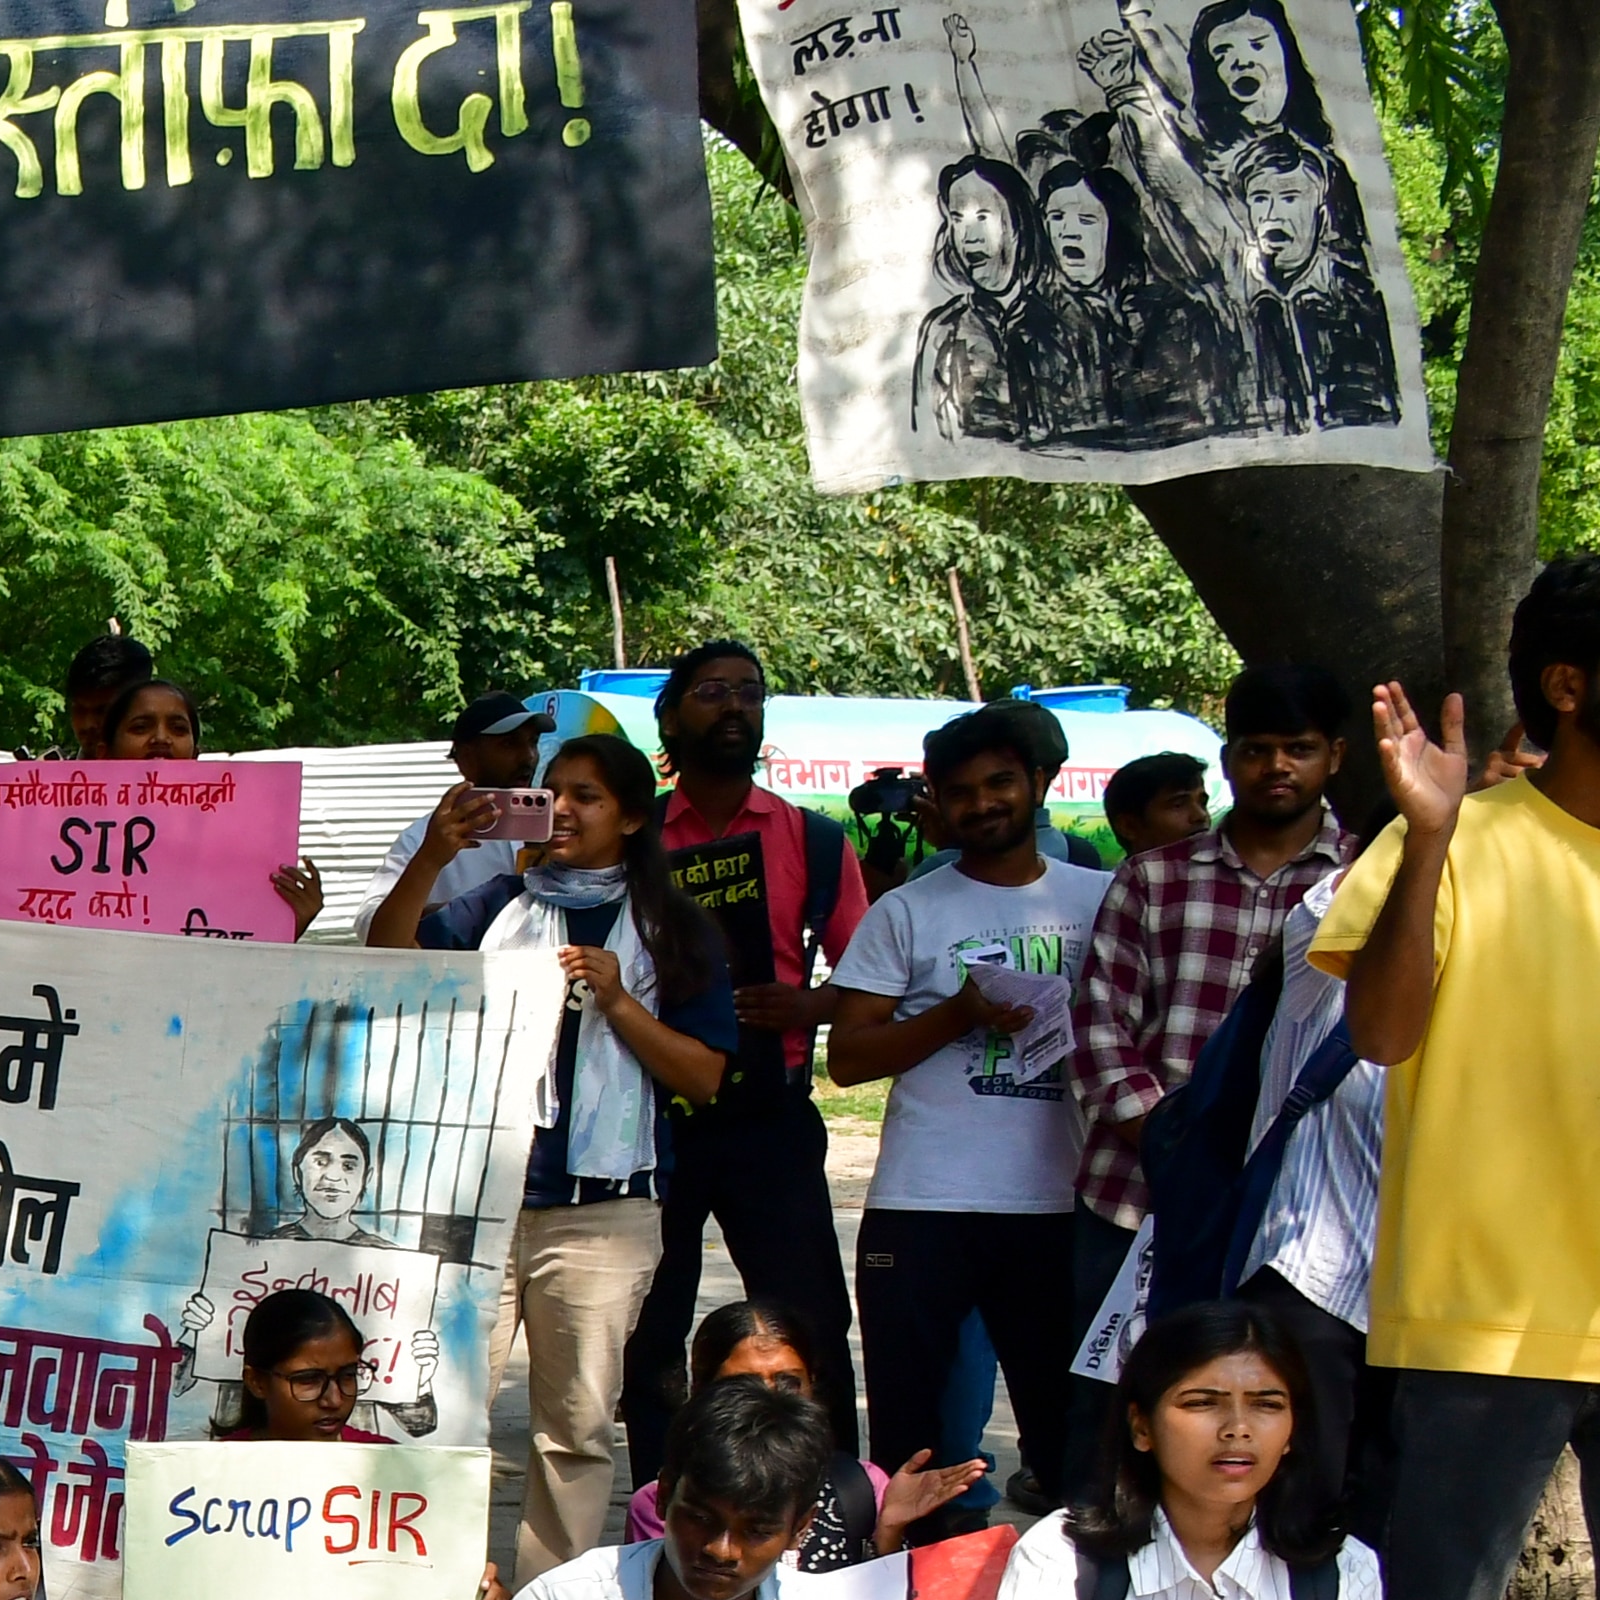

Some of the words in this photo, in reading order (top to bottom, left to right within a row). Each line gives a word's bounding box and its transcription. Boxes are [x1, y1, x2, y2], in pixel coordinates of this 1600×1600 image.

[790, 8, 901, 75] लड़ना
[804, 83, 924, 148] होगा!
[51, 816, 155, 876] SIR
[714, 853, 749, 879] BJP
[89, 881, 150, 924] करो!
[165, 1487, 311, 1552] Scrap
[323, 1486, 427, 1555] SIR
